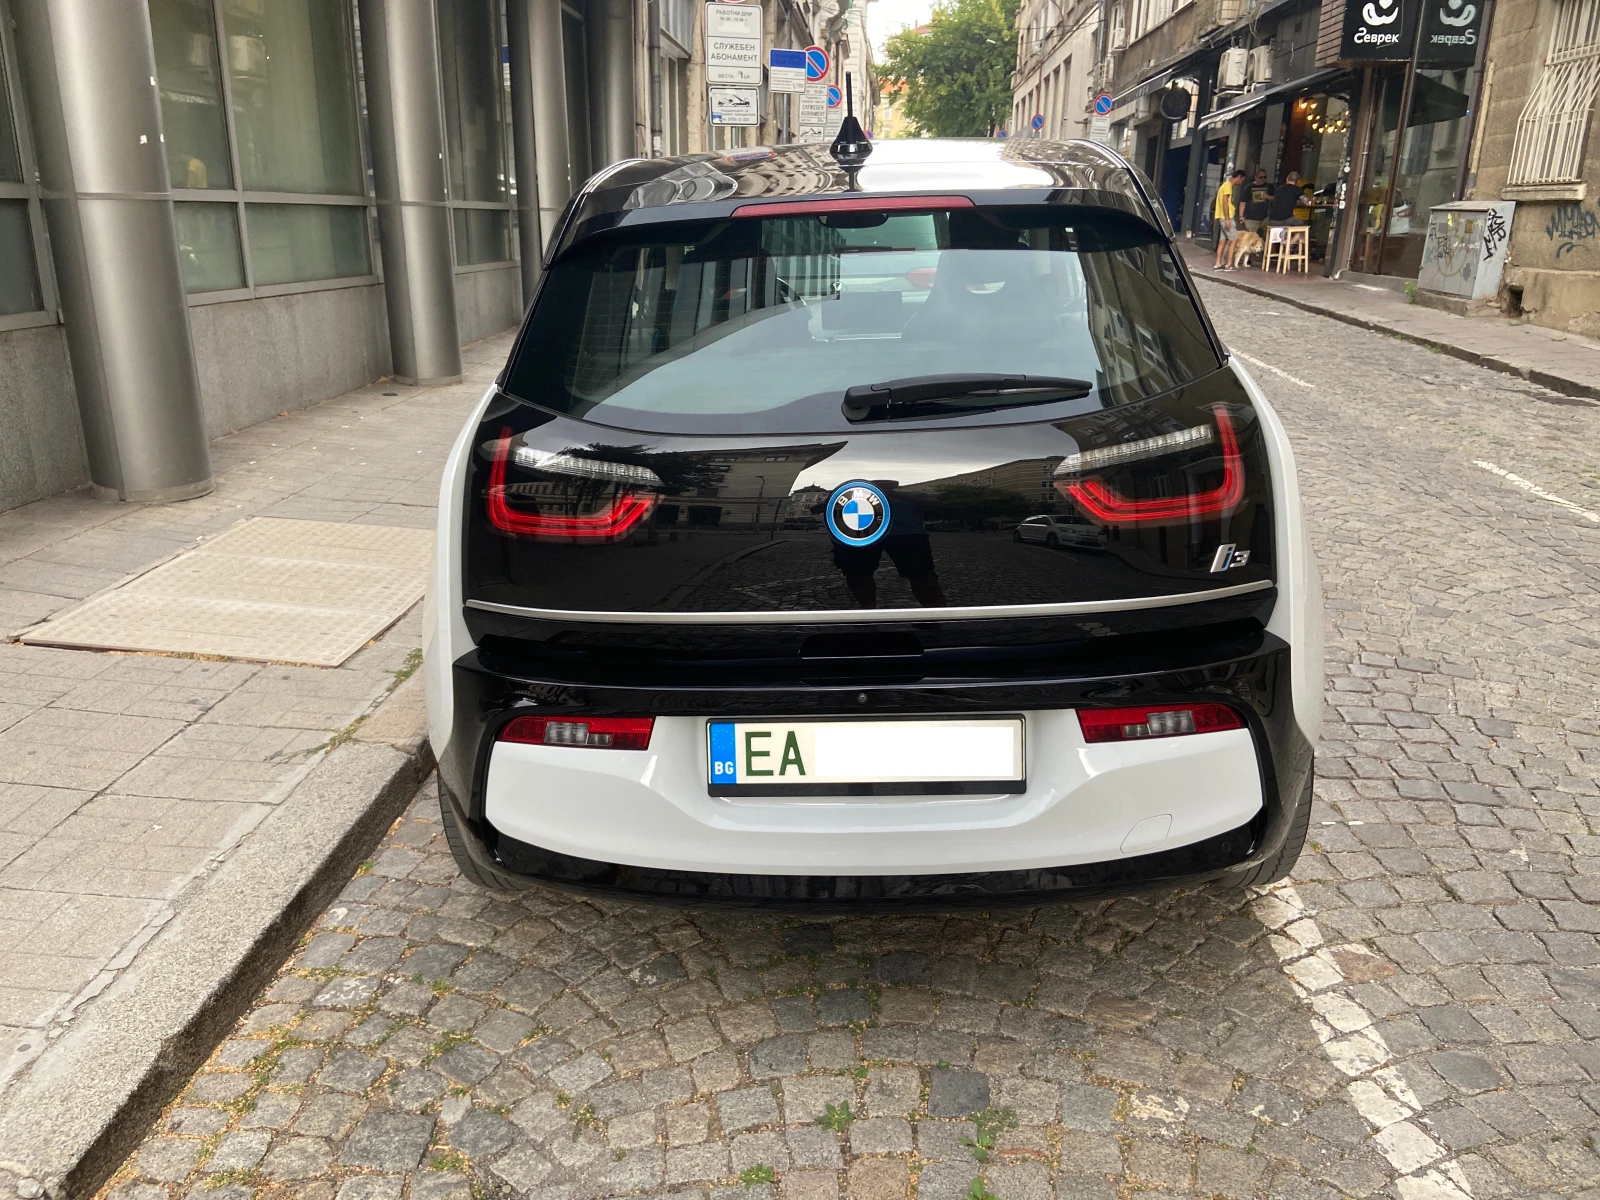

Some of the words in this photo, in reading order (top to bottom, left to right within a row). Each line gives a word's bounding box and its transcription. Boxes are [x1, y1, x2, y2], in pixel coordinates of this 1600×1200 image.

[713, 42, 755, 51] СЛУЖЕБЕН
[710, 53, 758, 62] АБОНАМЕНТ
[837, 489, 880, 506] BMW
[1210, 543, 1251, 573] i3
[745, 730, 807, 776] EA
[714, 761, 734, 775] BG
